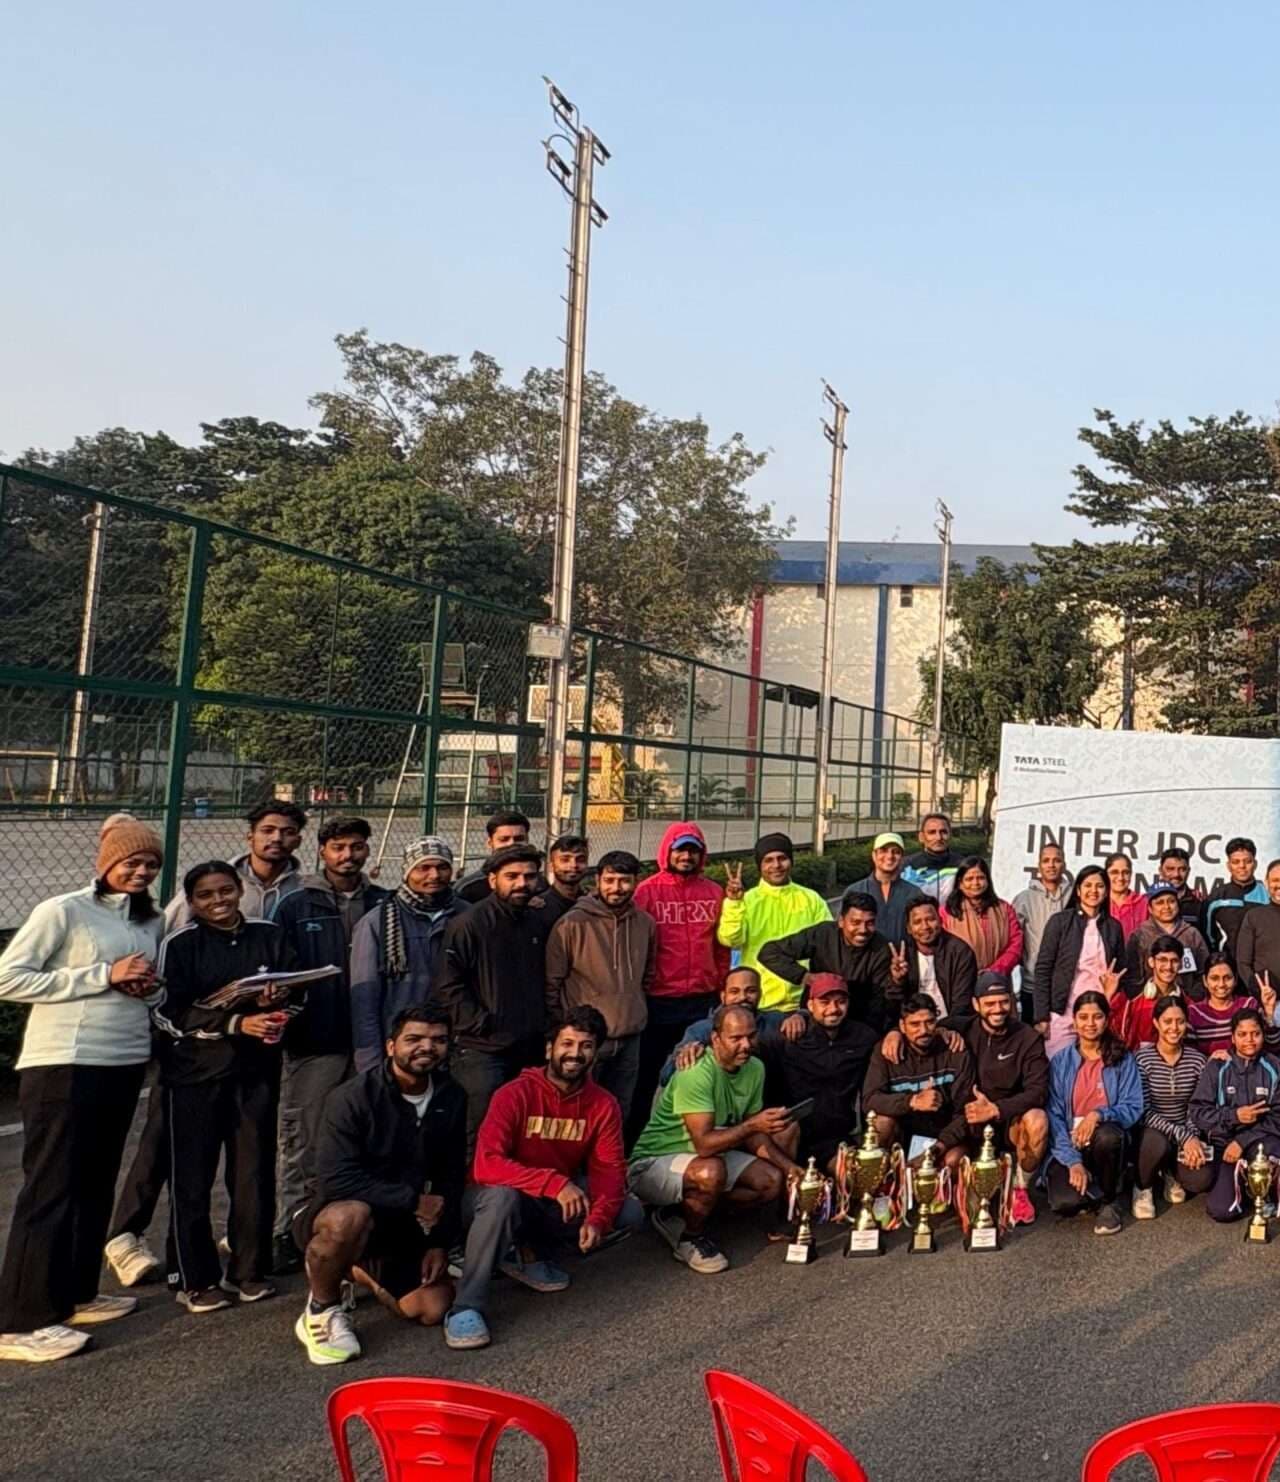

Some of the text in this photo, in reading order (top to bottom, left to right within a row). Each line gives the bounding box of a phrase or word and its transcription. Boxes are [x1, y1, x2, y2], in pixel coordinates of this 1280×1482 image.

[1014, 756, 1067, 767] TATA STEEL
[1026, 824, 1224, 865] INTER JDC
[656, 900, 717, 925] HRX
[526, 1116, 587, 1141] PUMA
